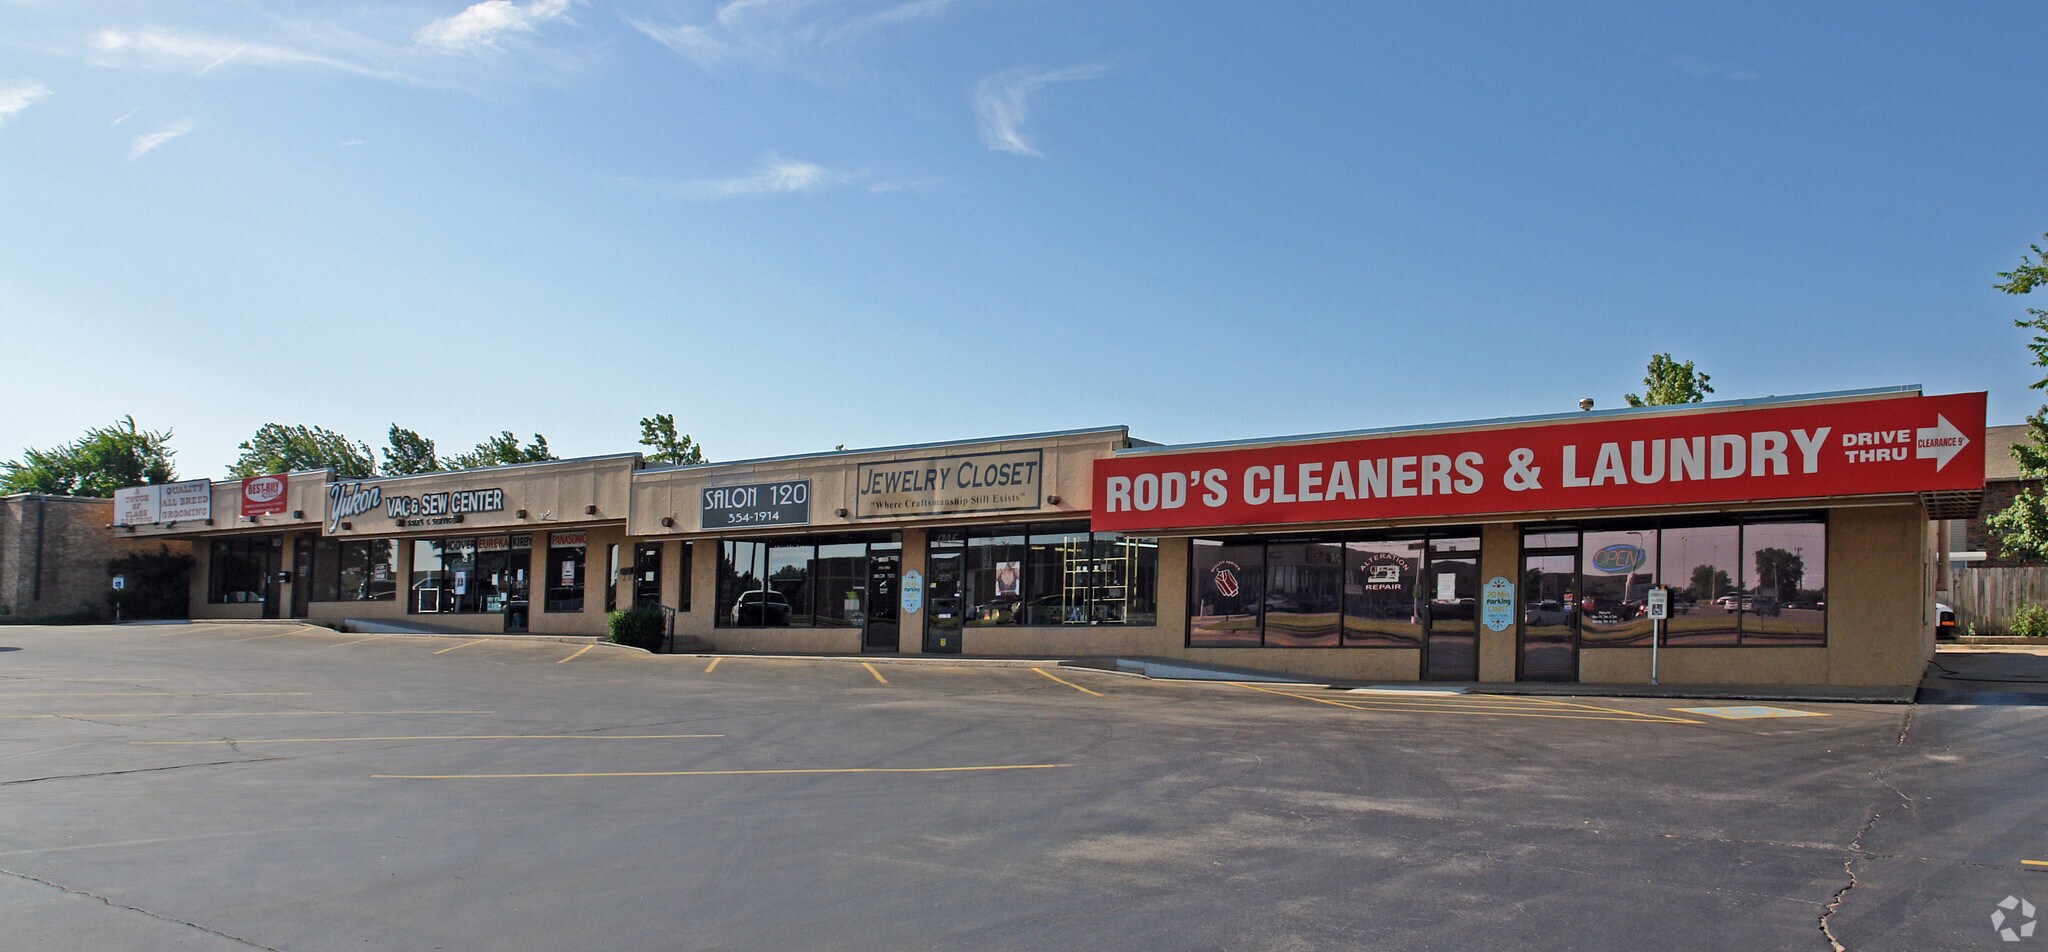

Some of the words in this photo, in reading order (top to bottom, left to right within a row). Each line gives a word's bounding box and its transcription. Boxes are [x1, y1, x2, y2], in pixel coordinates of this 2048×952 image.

[1841, 429, 1911, 447] DRIVE
[1917, 437, 1957, 449] CLEARANCE
[1844, 446, 1908, 464] THRU
[1105, 468, 1228, 513] ROD'S
[1243, 451, 1484, 505] CLEANERS
[1503, 447, 1542, 492] &
[1562, 426, 1832, 488] LAUNDRY
[166, 483, 204, 495] QUALITY
[125, 494, 149, 503] TOUCH
[162, 498, 177, 507] ALL
[180, 496, 208, 505] BREED
[421, 492, 449, 516] SEW
[451, 488, 503, 514] CENTER
[704, 487, 757, 511] SALON
[769, 483, 806, 507] 120
[904, 495, 968, 508] Craftsmanship
[970, 493, 990, 505] Still
[126, 509, 148, 518] CLASS
[162, 508, 207, 519] GROOMING
[328, 483, 380, 534] Yukon
[728, 510, 780, 523] 354-1914
[478, 536, 508, 549] EUREKA
[512, 535, 533, 548] KIRBY
[552, 533, 587, 545] PANASONIC
[1360, 553, 1410, 572] ALTERATION
[1595, 550, 1638, 567] OPEN
[1486, 597, 1511, 606] Parking
